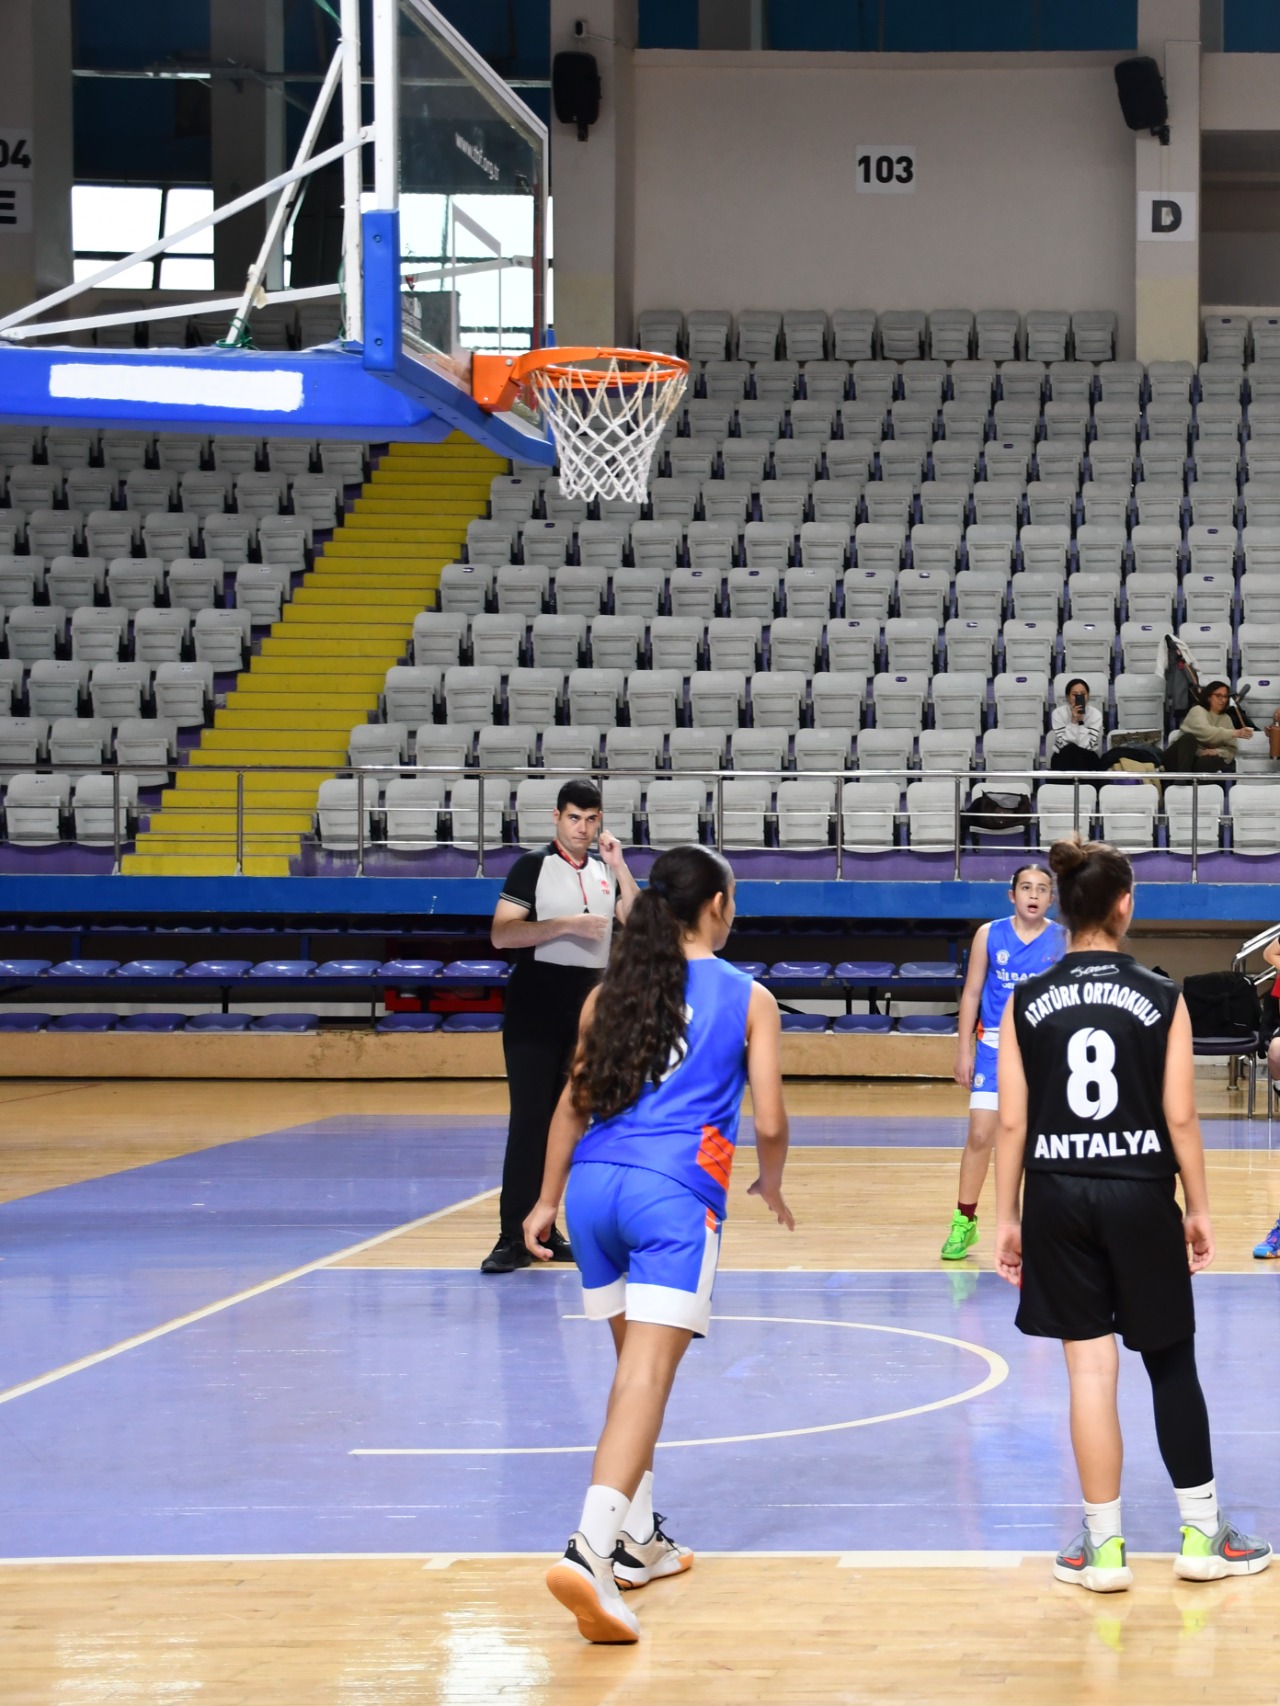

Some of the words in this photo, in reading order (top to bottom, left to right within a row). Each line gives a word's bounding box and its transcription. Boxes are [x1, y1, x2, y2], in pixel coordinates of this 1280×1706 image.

[858, 155, 913, 183] 103
[1152, 200, 1182, 233] D
[1024, 984, 1081, 1028] ATATÜRK
[1083, 982, 1162, 1027] ORTAOKULU
[1067, 1027, 1119, 1120] 8
[1034, 1129, 1162, 1159] ANTALYA
